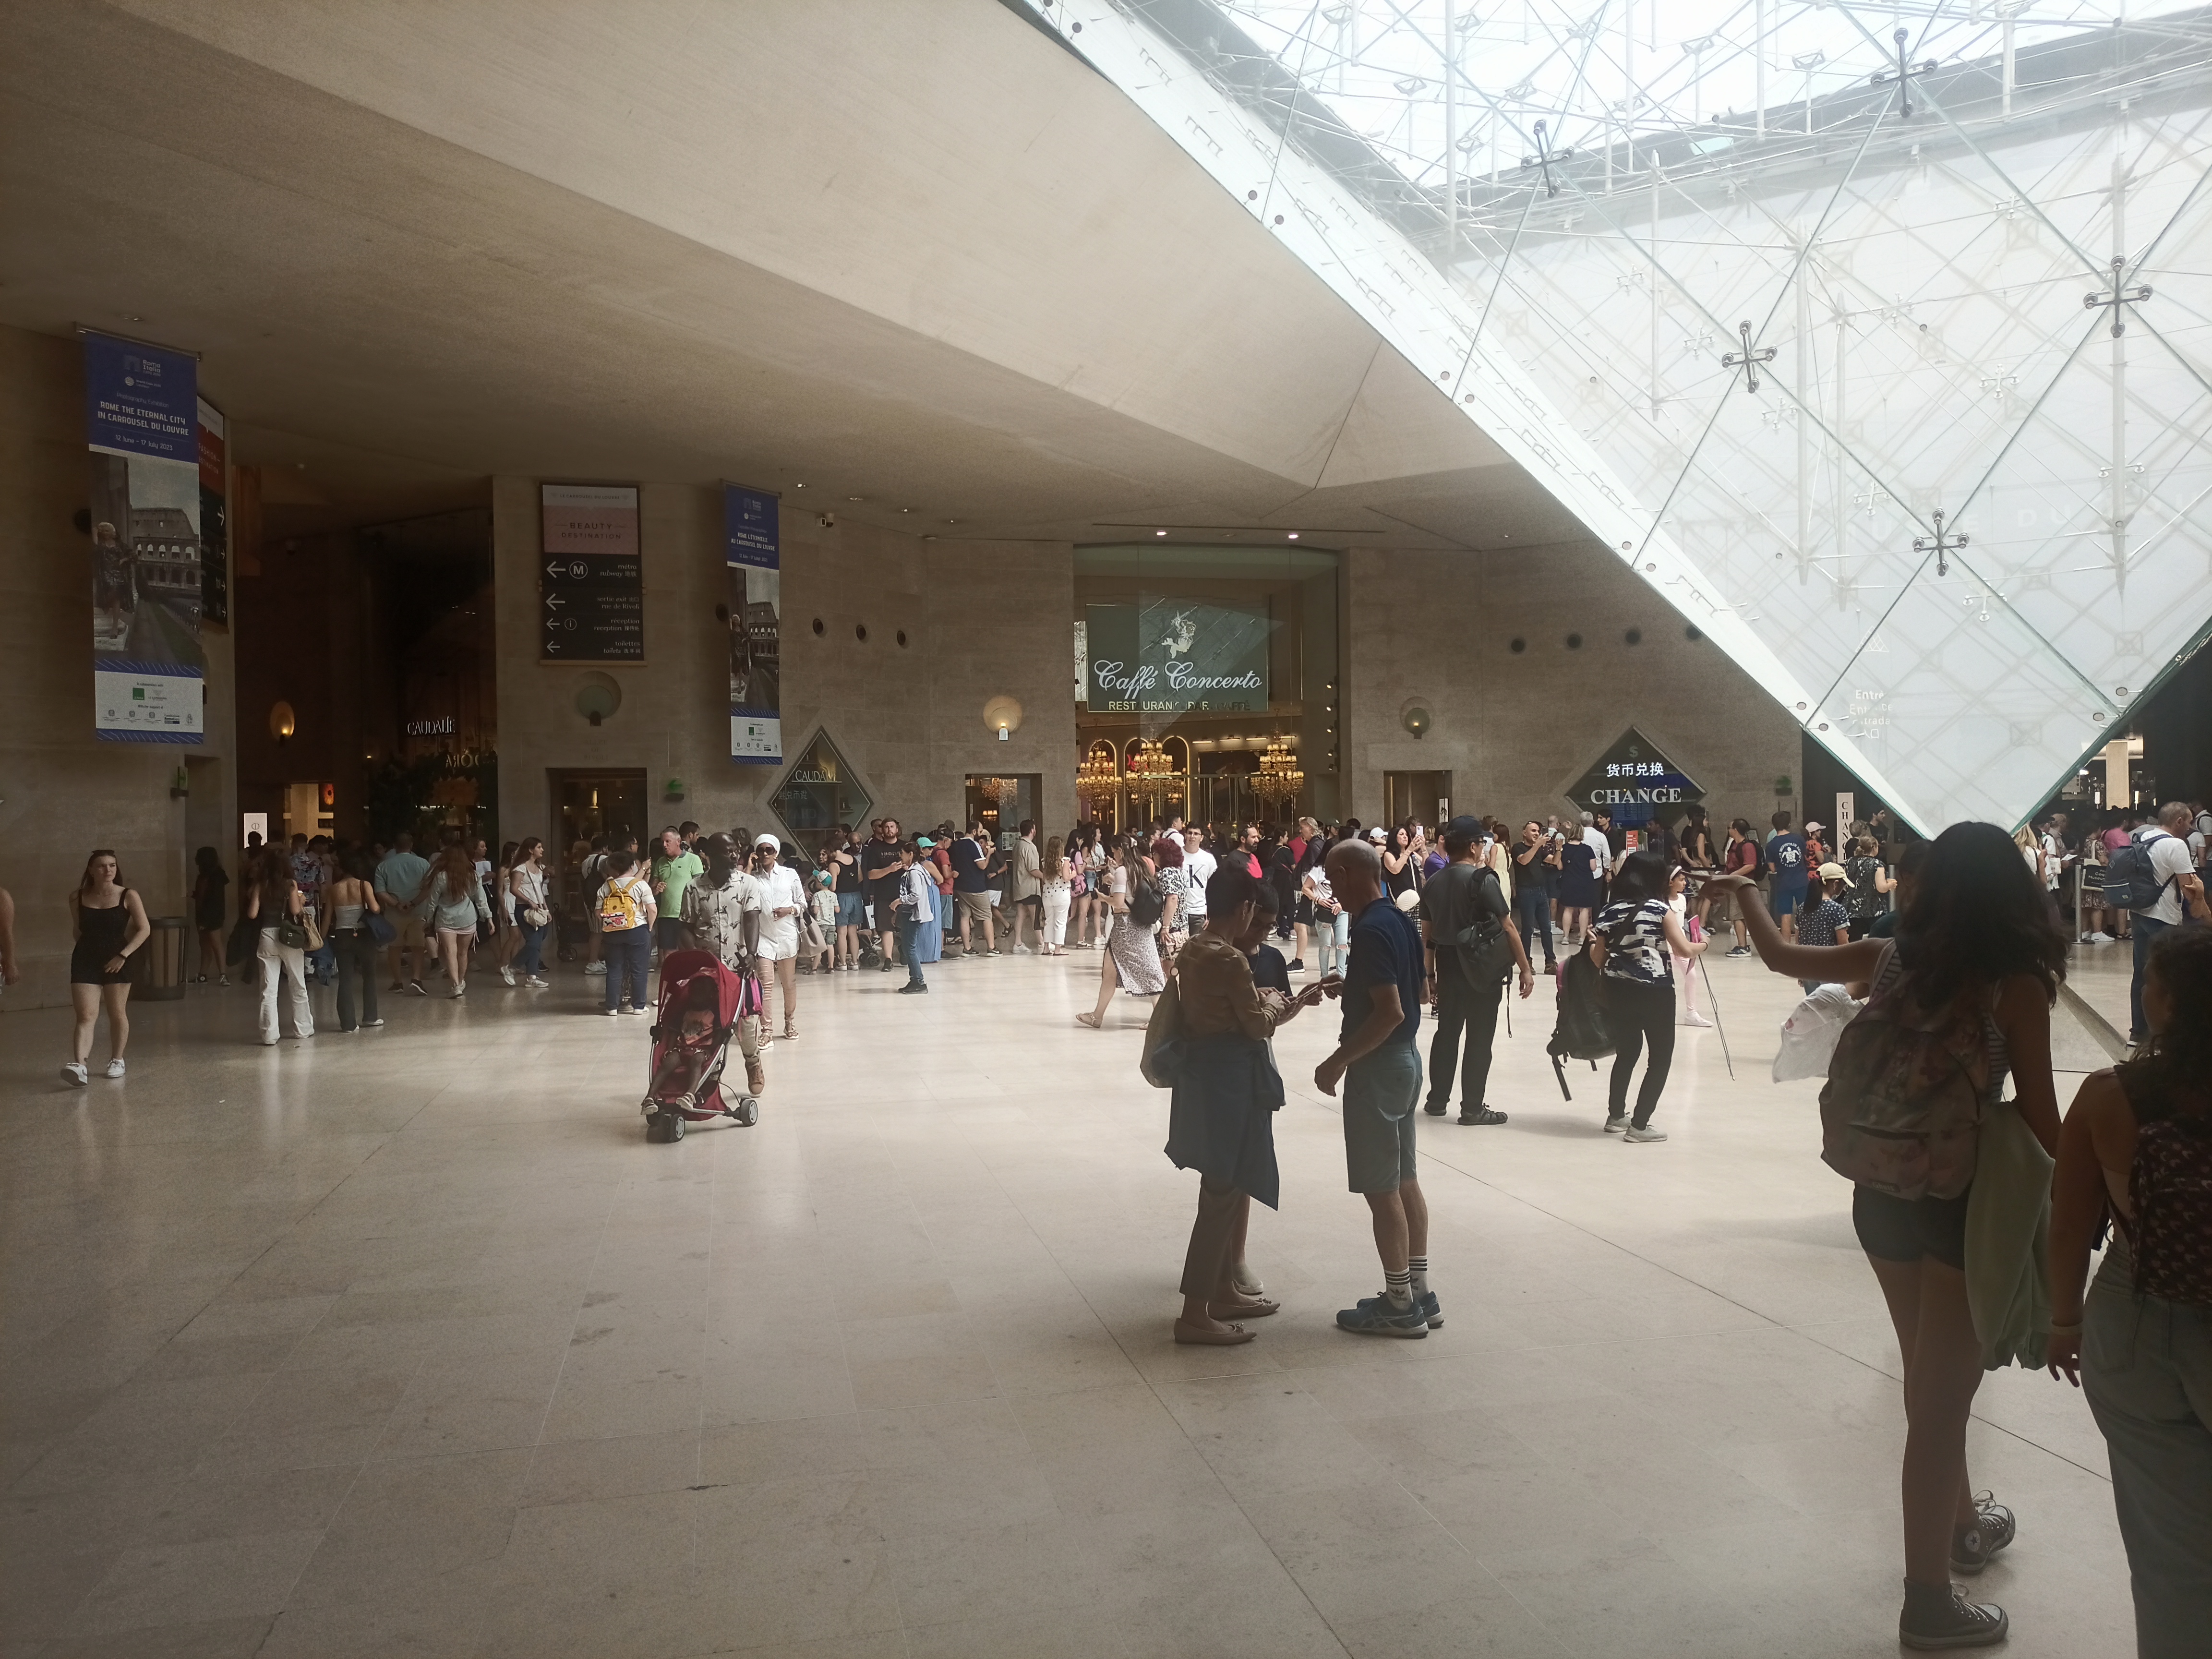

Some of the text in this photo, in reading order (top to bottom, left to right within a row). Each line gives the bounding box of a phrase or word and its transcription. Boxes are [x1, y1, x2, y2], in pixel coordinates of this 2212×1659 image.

[143, 360, 160, 368] Roma
[144, 365, 160, 373] Italia
[100, 401, 186, 425] ROME THE ETERNAL CITY
[108, 413, 149, 428] CARROUSEL
[151, 422, 160, 430] DU
[163, 424, 189, 435] LOUVRE
[148, 441, 158, 449] July
[573, 565, 584, 575] M
[611, 618, 640, 626] réception
[1094, 660, 1262, 699] Caffé Concerto
[1855, 689, 1887, 700] Entré
[1606, 762, 1664, 777] 货币兑换
[1591, 788, 1682, 804] CHANGE
